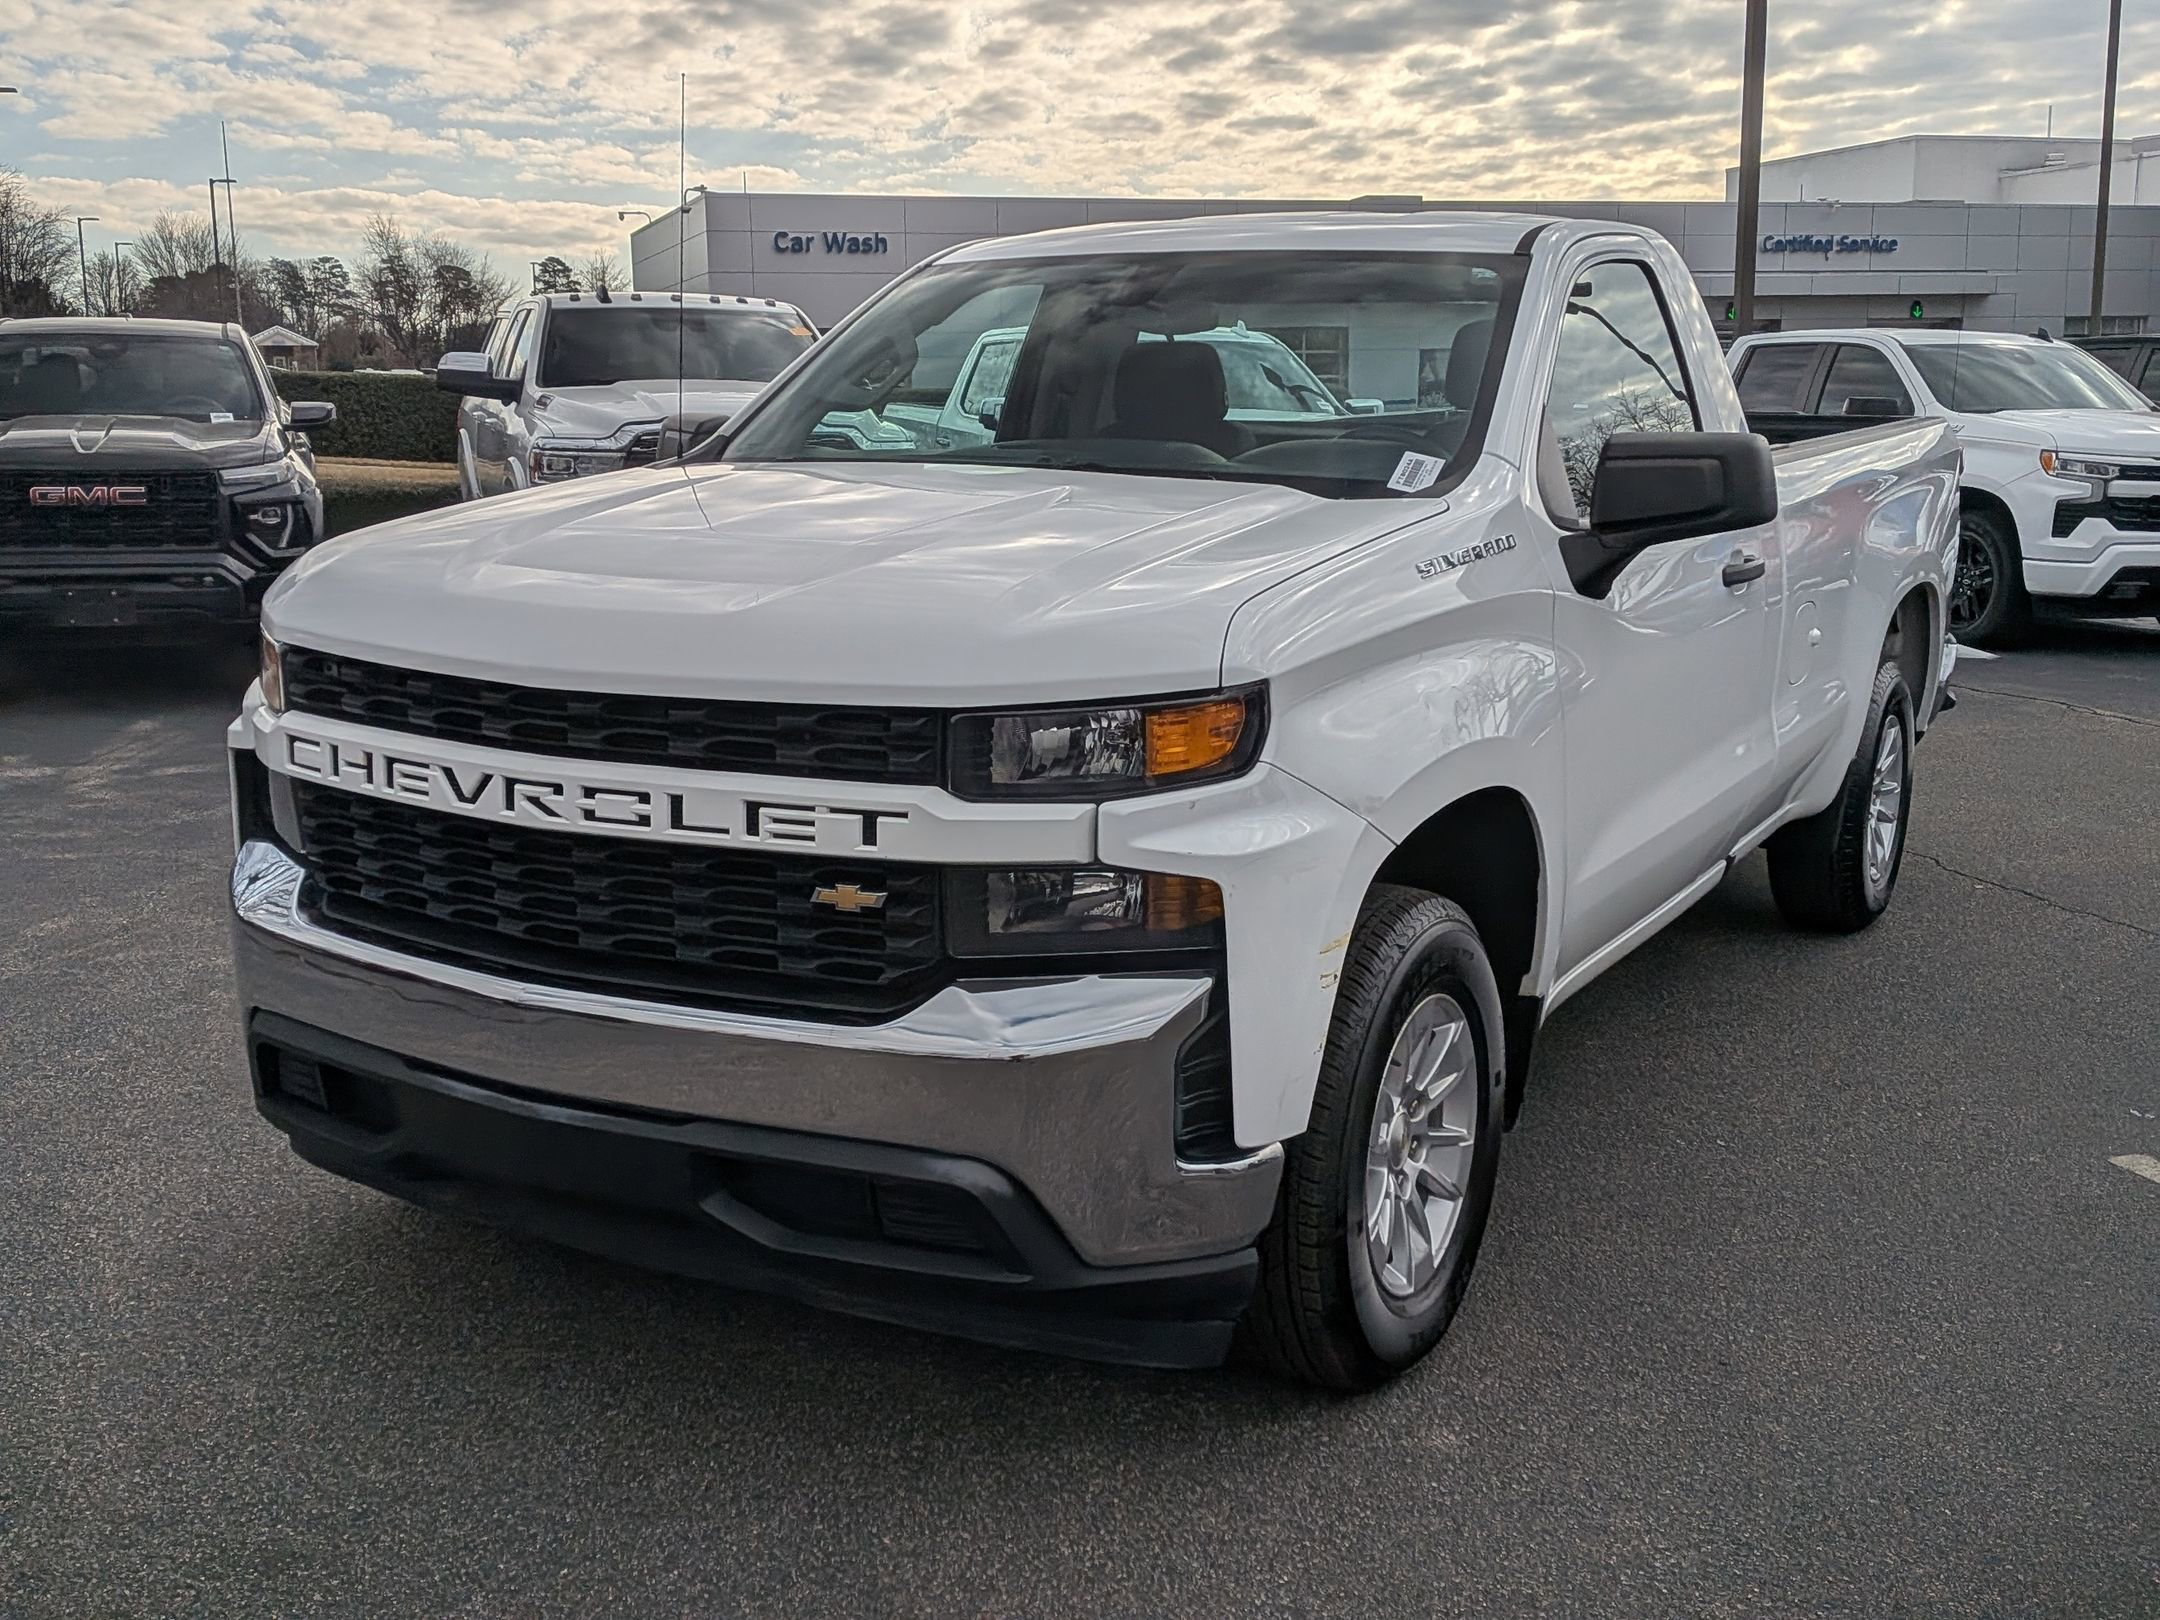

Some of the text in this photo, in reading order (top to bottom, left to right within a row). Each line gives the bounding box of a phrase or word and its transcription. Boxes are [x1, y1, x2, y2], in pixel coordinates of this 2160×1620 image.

[774, 231, 888, 254] Car Wash
[1762, 234, 1898, 254] Certified Service
[29, 486, 147, 506] GMC
[1415, 533, 1517, 580] SILVERADO
[284, 732, 911, 852] CHEVROLET
